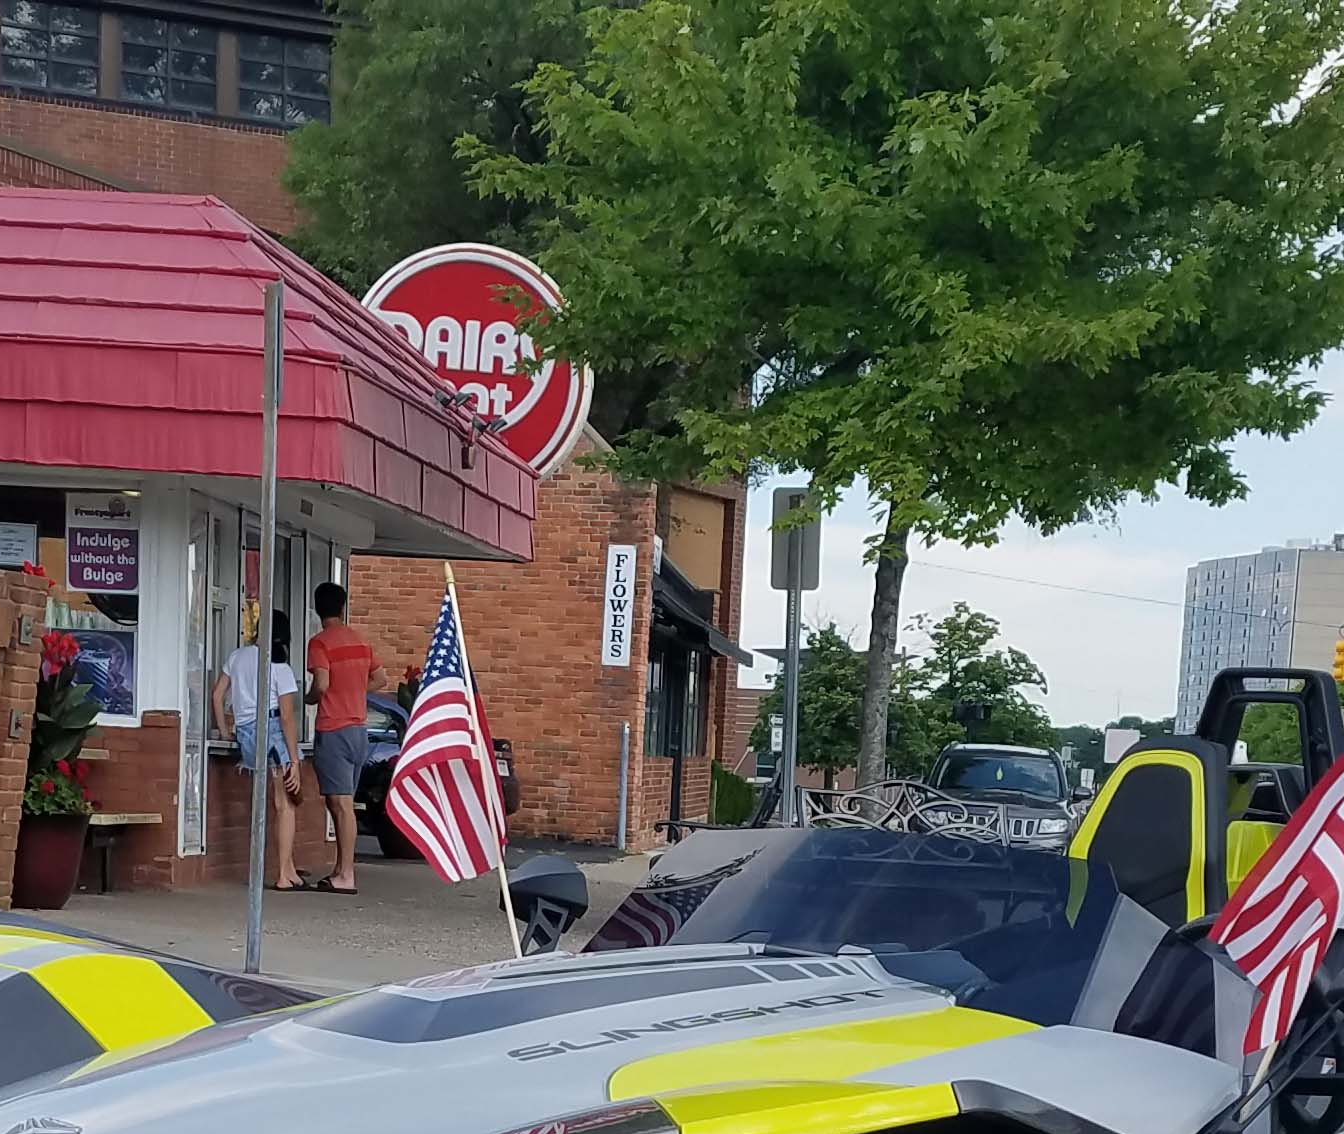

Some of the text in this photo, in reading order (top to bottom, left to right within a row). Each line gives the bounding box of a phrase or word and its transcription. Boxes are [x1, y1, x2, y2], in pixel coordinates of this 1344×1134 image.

[76, 532, 131, 551] Indulge
[70, 552, 136, 565] without the
[83, 567, 124, 585] Bulge
[609, 554, 628, 658] FLOWERS
[507, 989, 886, 1062] SLINGSHOT
